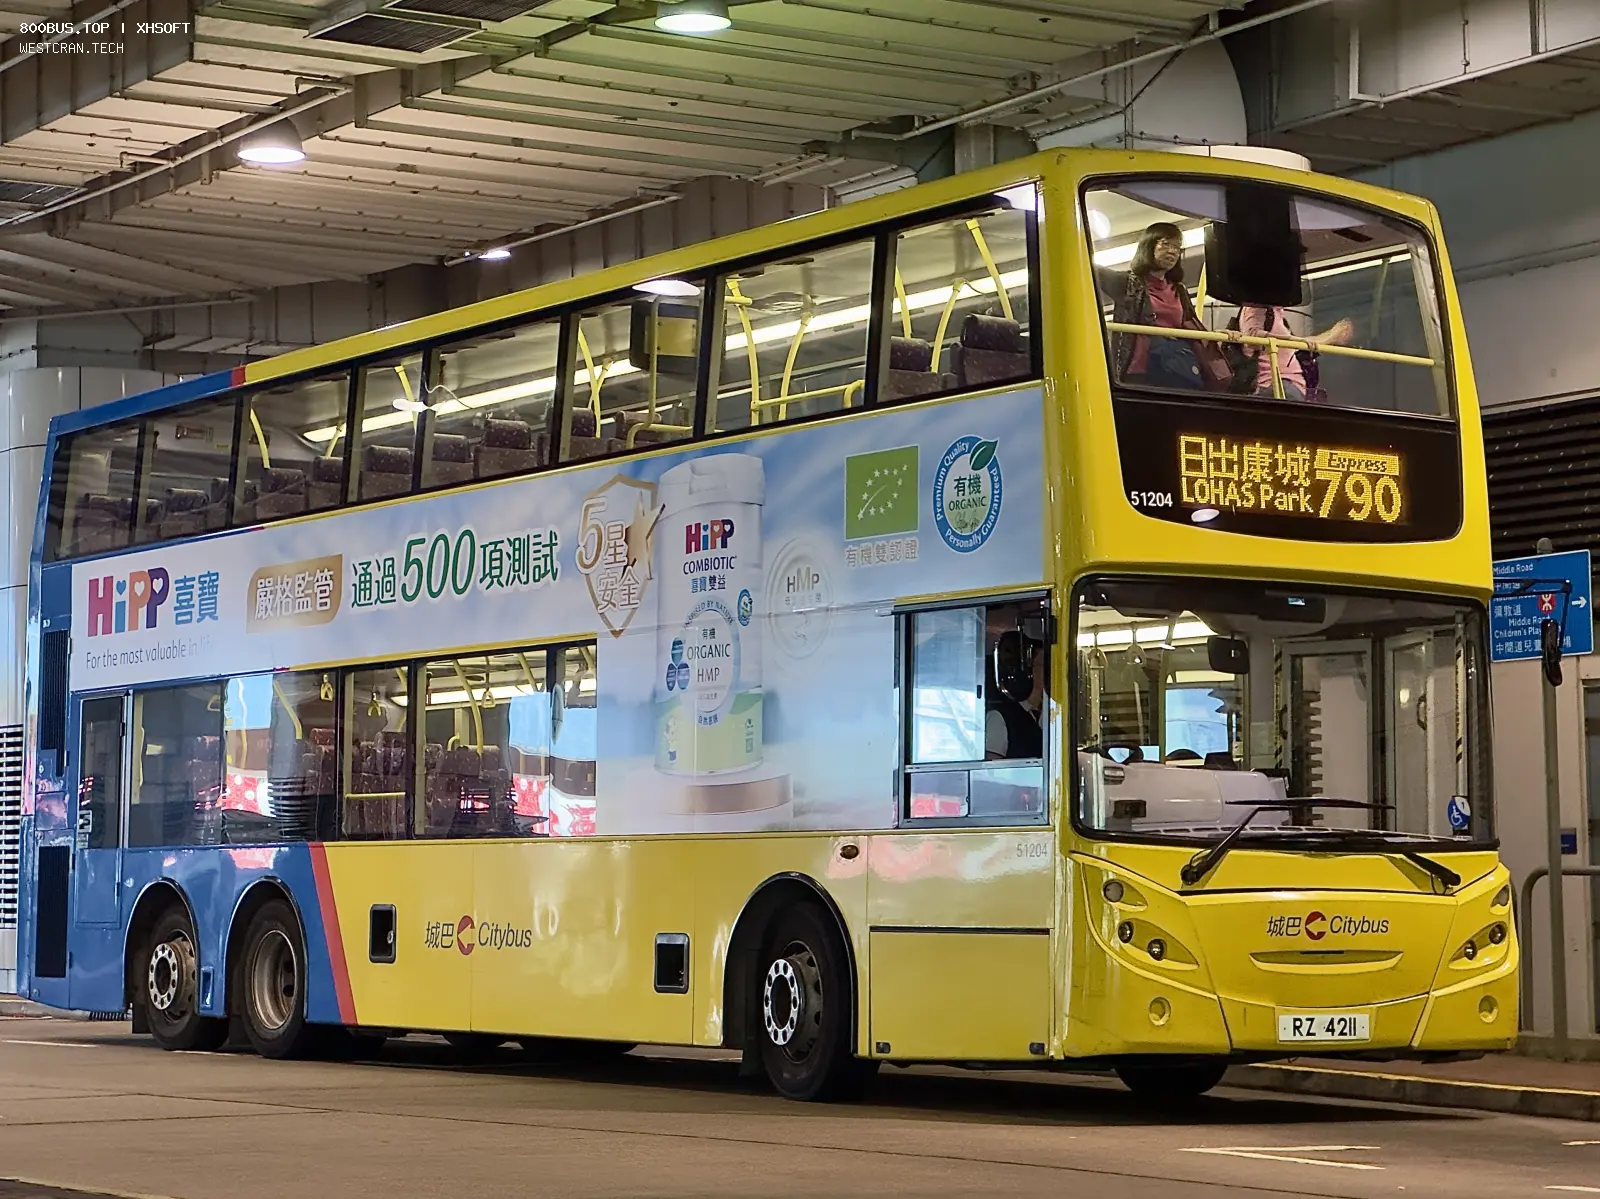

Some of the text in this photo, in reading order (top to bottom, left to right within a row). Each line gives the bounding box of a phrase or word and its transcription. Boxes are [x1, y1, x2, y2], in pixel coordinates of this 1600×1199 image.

[1180, 435, 1311, 487] 日出康城
[1328, 451, 1388, 472] Express
[934, 440, 970, 521] Premium Quality
[953, 473, 982, 498] 有機
[944, 528, 982, 549] Personally
[980, 467, 1000, 536] Guaranteed
[948, 496, 987, 512] ORGANIC
[1130, 490, 1173, 508] 51204
[1180, 476, 1314, 513] LOHAS Park
[1315, 469, 1402, 523] 790
[685, 519, 735, 555] HiPP
[351, 528, 559, 609] 通過500項測試
[683, 556, 736, 575] COMBIOTIC
[1493, 563, 1534, 575] Middle Road
[598, 567, 641, 610] 安全
[786, 566, 820, 593] HMP
[87, 566, 170, 637] HiPP
[173, 570, 220, 626] 喜寶
[254, 567, 334, 621] 嚴格監管
[1494, 627, 1527, 639] Children's
[1508, 617, 1532, 627] Middle
[86, 651, 101, 669] For
[102, 648, 118, 668] the
[119, 647, 143, 665] most
[145, 639, 187, 662] valuable
[686, 643, 731, 660] ORGANIC
[697, 667, 720, 682] HMP
[1016, 842, 1048, 858] 51204
[425, 921, 455, 949] 城巴
[478, 921, 532, 950] Citybus
[1266, 915, 1302, 937] 城巴
[1329, 915, 1389, 936] Citybus
[1292, 1017, 1357, 1037] RZ 4211
